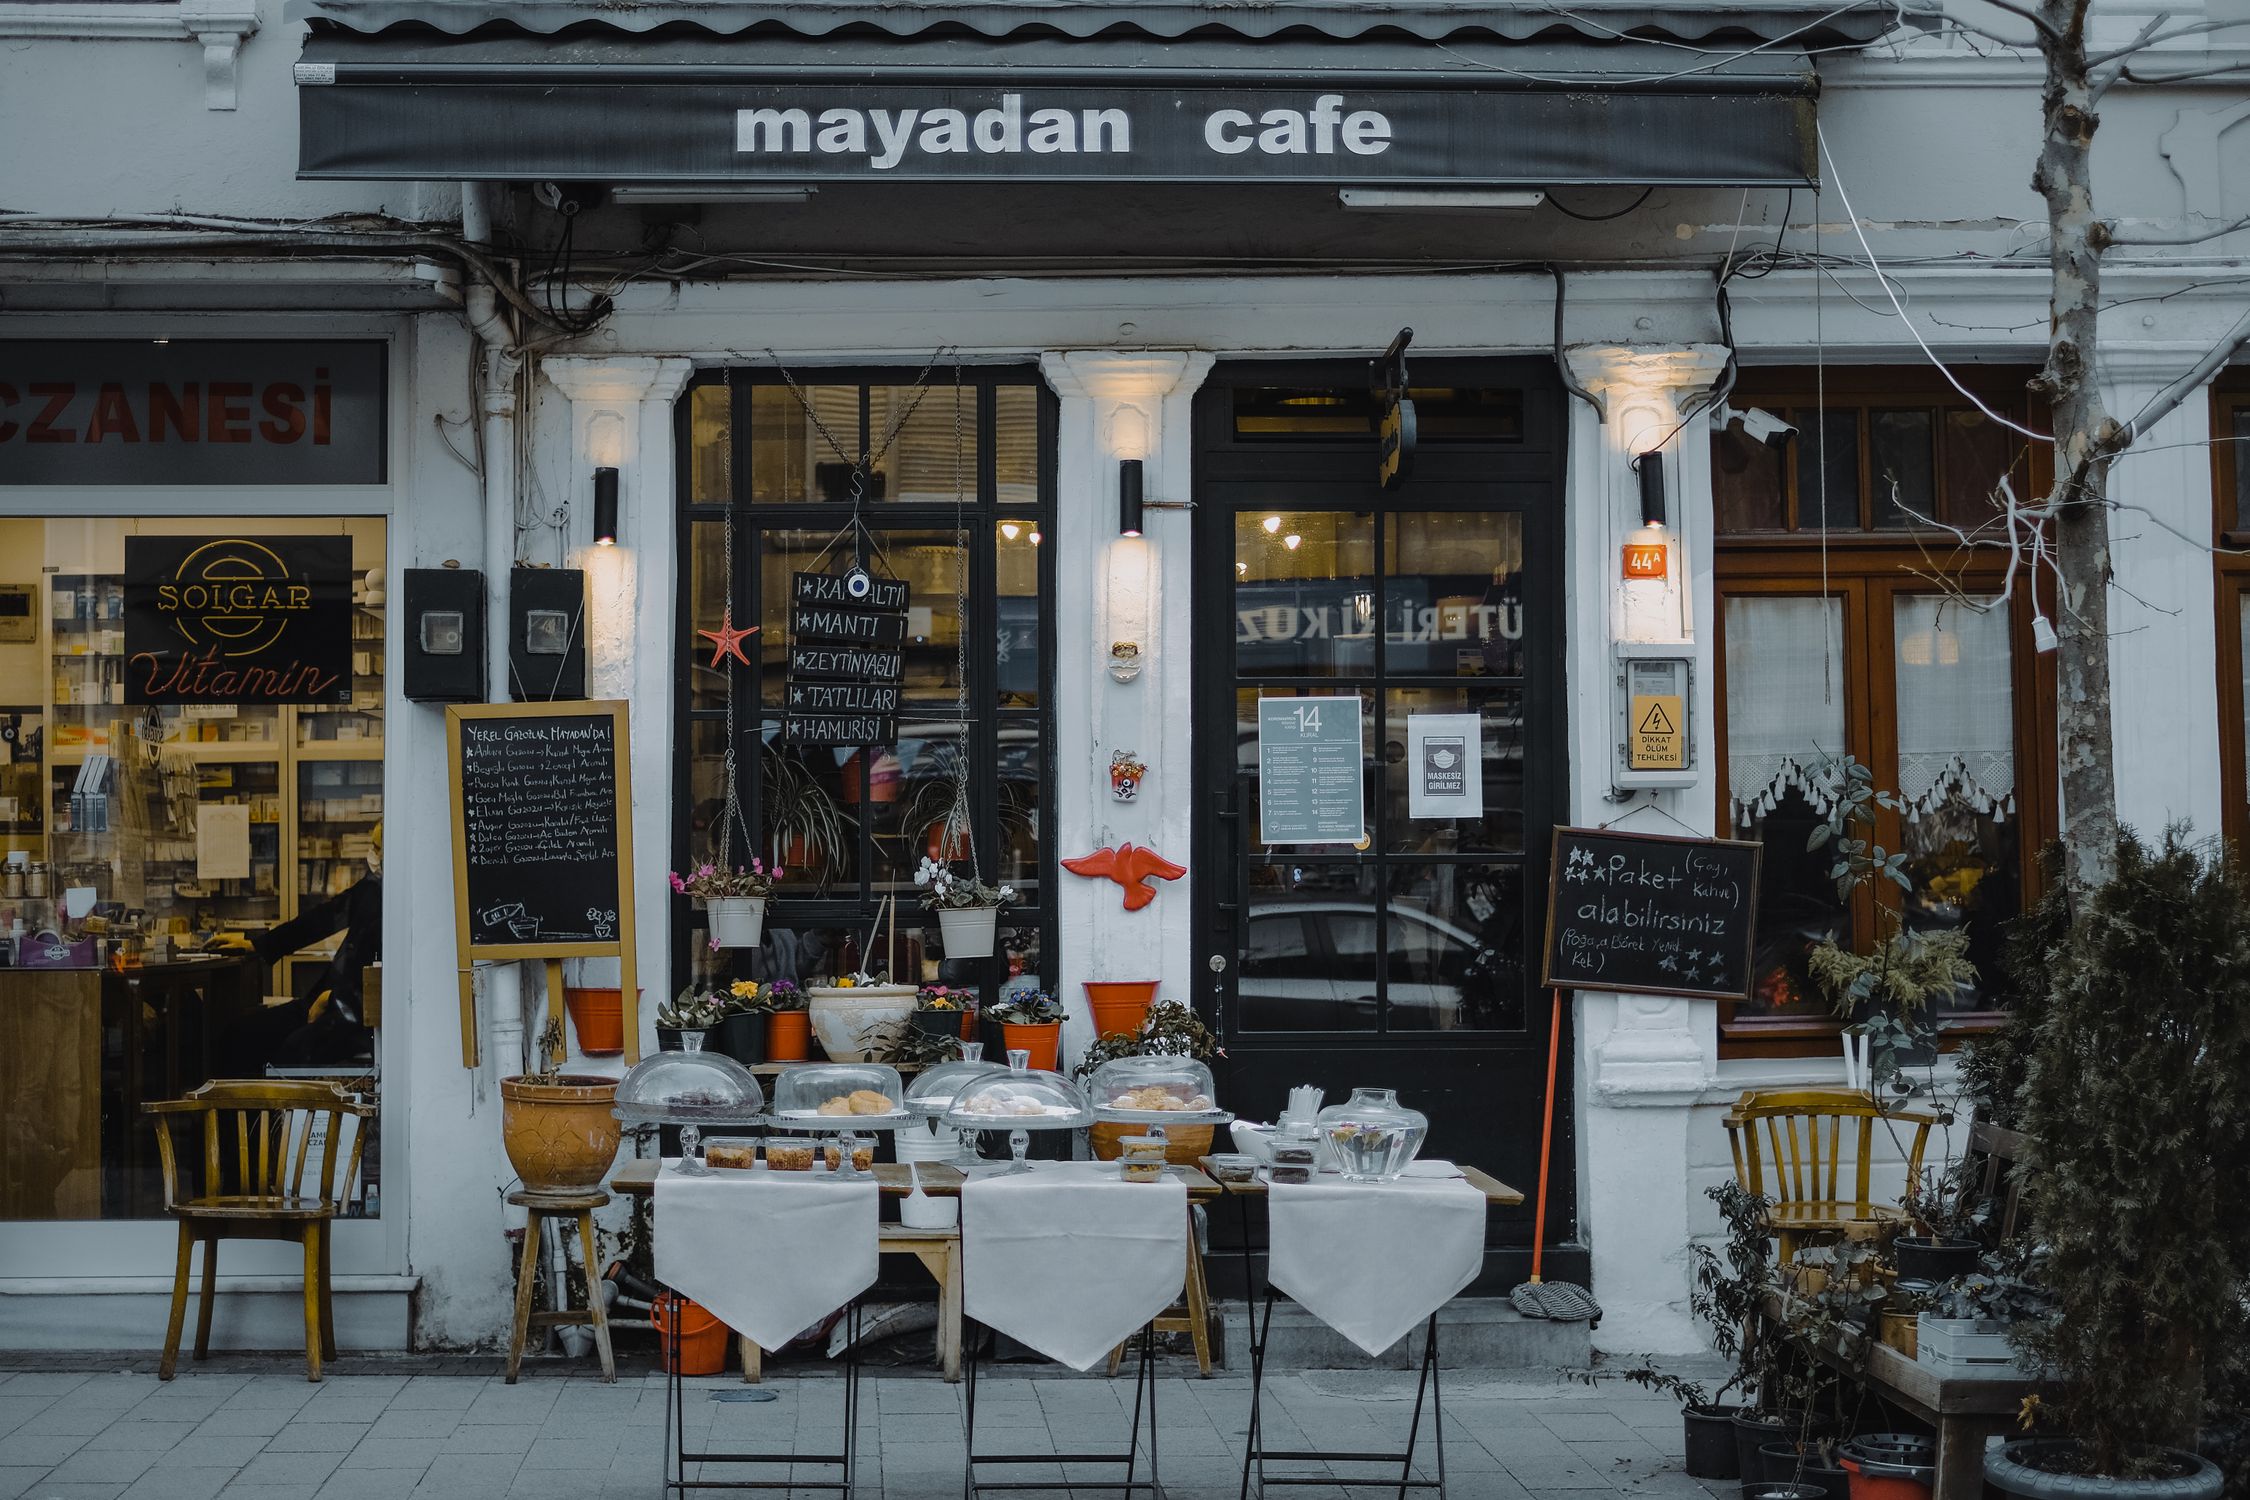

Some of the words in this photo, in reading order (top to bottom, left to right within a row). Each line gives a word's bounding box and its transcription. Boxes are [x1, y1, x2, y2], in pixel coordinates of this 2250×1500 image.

[736, 95, 1131, 169] mayadan
[1204, 95, 1393, 156] cafe
[158, 585, 311, 614] SOLGAR
[815, 577, 901, 607] KAALTI
[811, 612, 879, 637] MANTI
[129, 643, 340, 696] Vitamin
[803, 716, 881, 742] HAMURİŞİ
[1293, 706, 1322, 732] 14
[468, 726, 501, 742] YEREL
[1642, 735, 1671, 743] DİKKAT
[1637, 752, 1677, 762] TEHLİKESİ
[1646, 743, 1668, 752] ÖLÜM
[1427, 771, 1462, 780] MASKESİZ
[1428, 781, 1461, 790] GİRİLMEZ
[1609, 854, 1683, 890] Paket
[1578, 895, 1725, 935] alabilirsiniz
